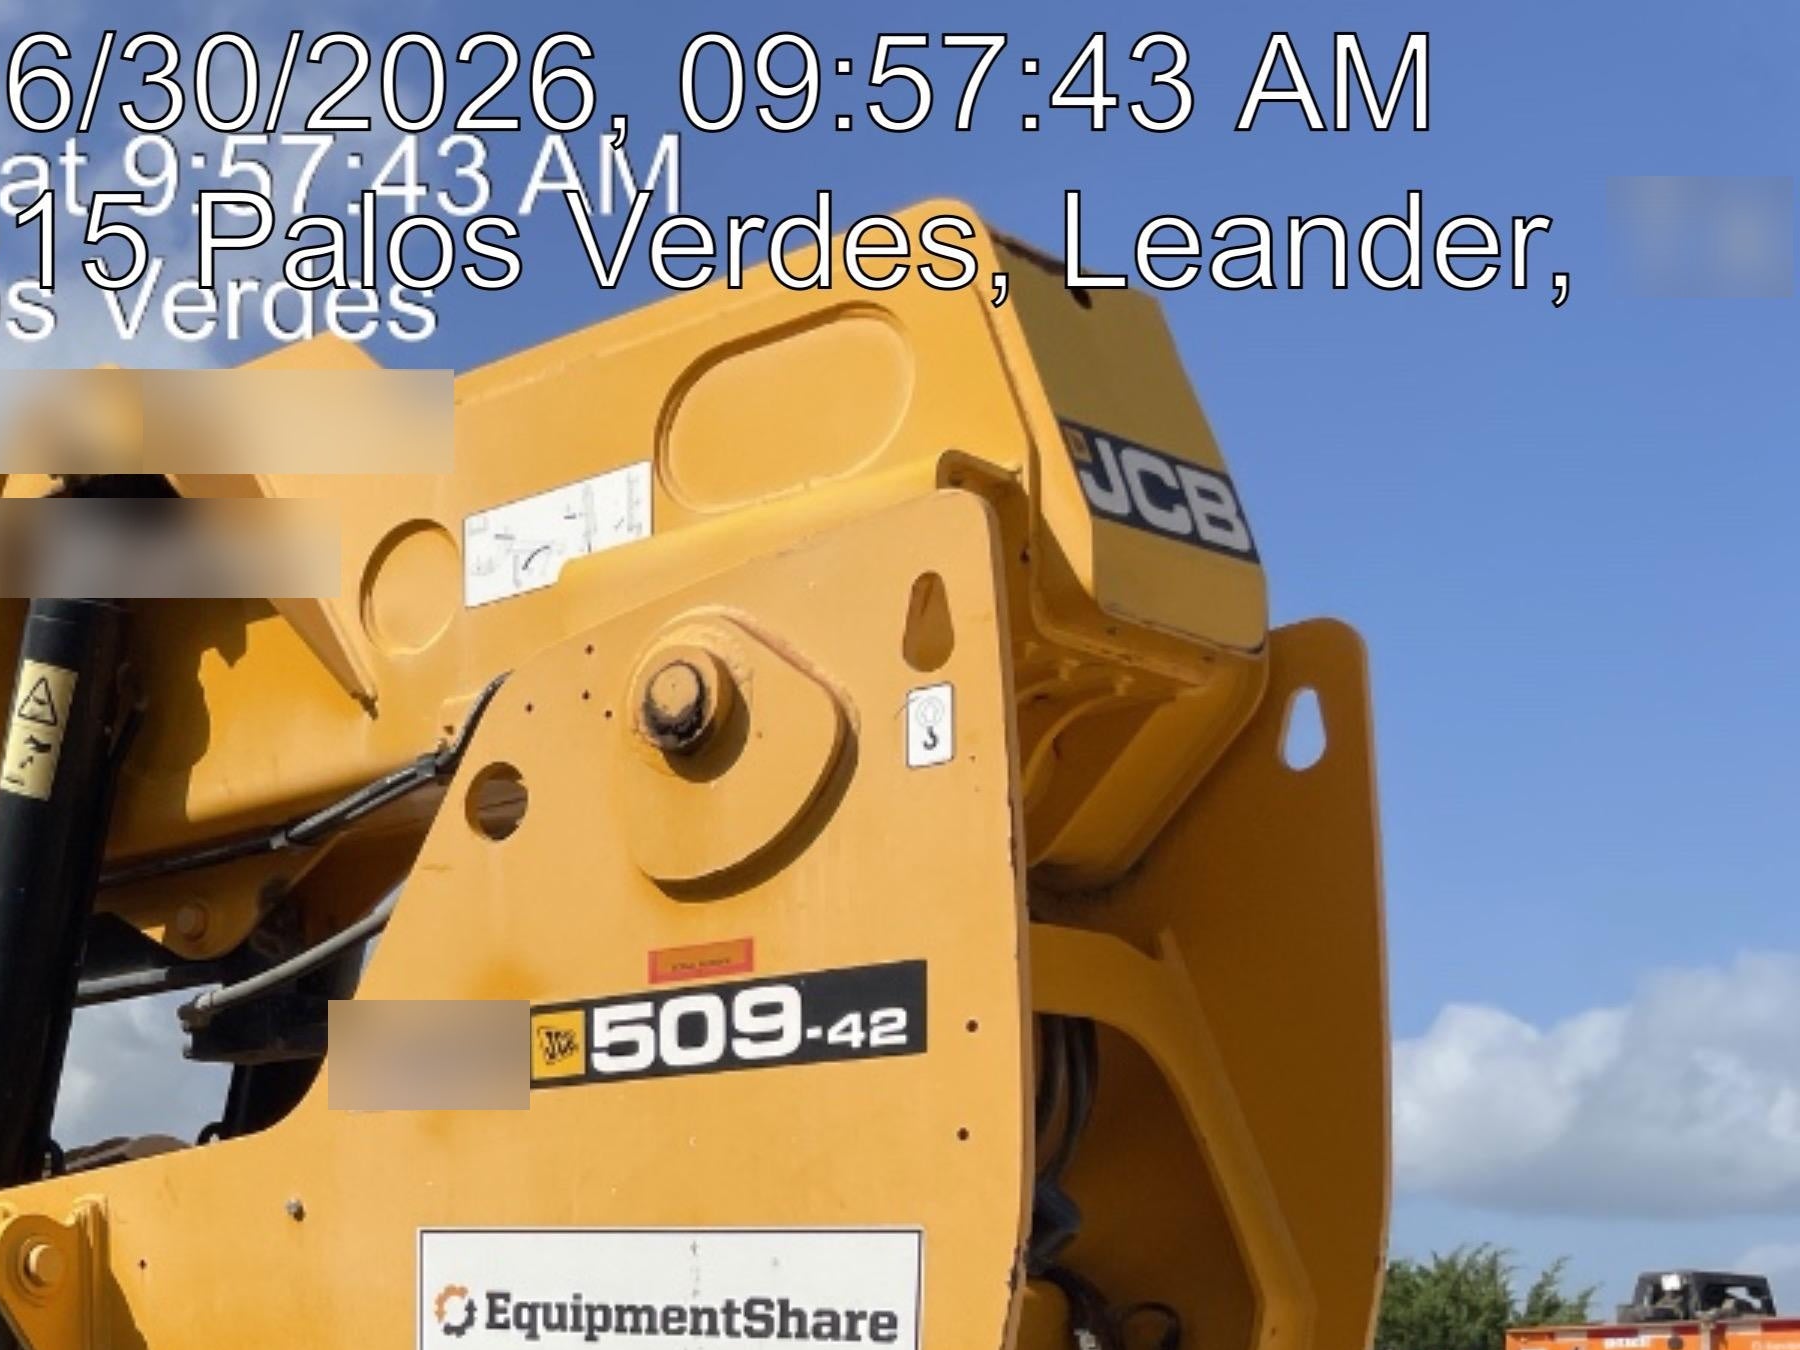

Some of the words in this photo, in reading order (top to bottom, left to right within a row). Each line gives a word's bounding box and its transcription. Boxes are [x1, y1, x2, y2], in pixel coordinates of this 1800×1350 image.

[1078, 437, 1252, 553] JCB
[590, 984, 908, 1074] 509-42
[485, 1290, 899, 1344] EquipmentShare
